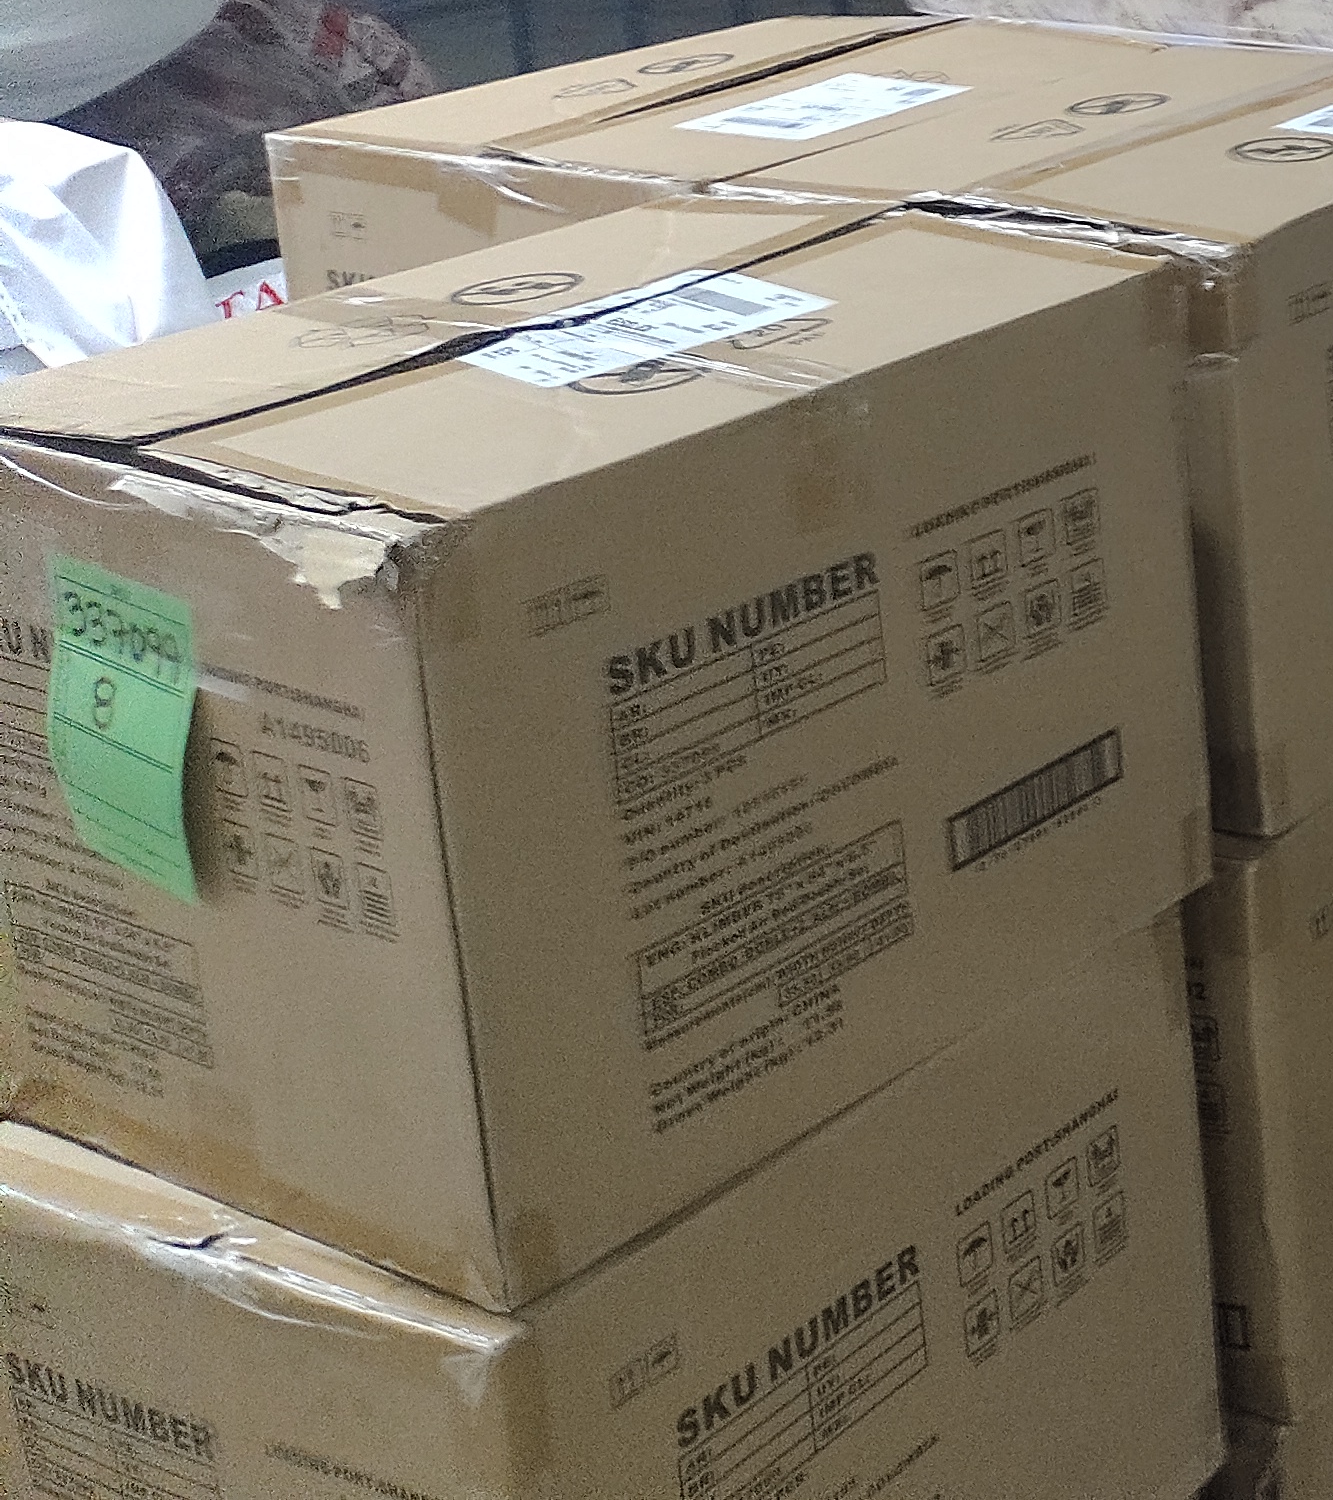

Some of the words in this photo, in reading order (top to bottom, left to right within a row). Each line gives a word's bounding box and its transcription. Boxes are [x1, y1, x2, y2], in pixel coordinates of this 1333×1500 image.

[608, 624, 696, 697] SKU
[706, 551, 880, 653] NUMBER
[93, 674, 117, 729] 8
[677, 1361, 756, 1448] SKU
[768, 1245, 919, 1381] NUMBER
[75, 1378, 217, 1463] NUMBER
